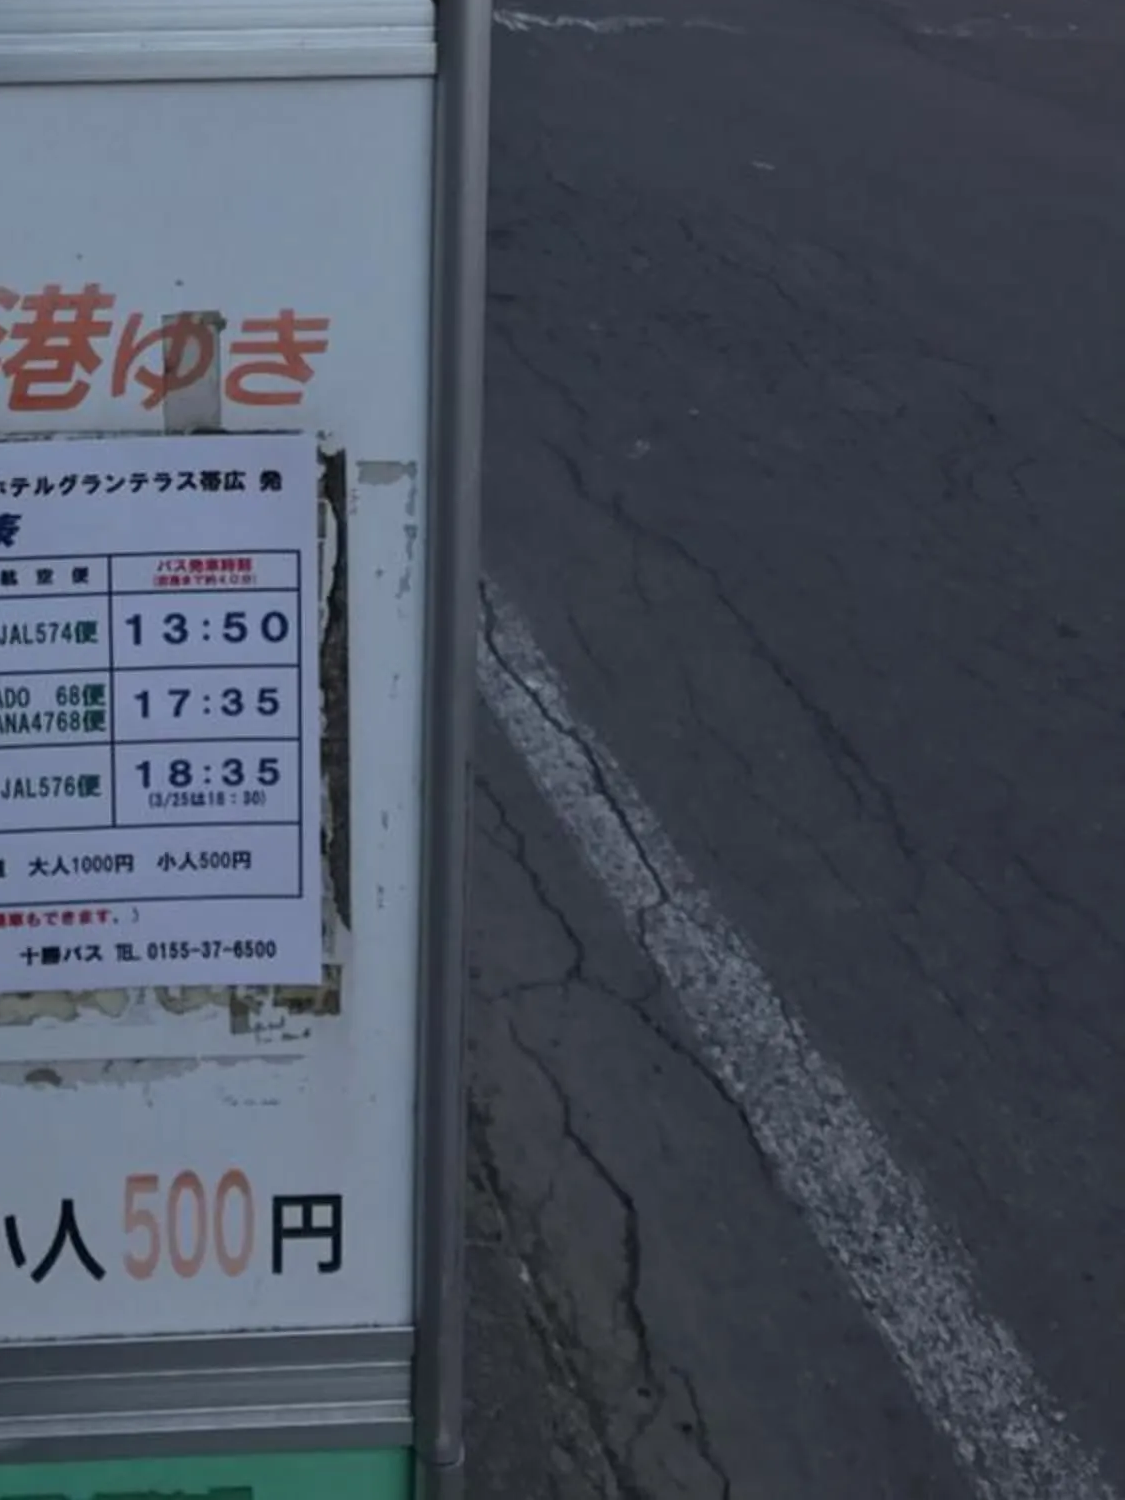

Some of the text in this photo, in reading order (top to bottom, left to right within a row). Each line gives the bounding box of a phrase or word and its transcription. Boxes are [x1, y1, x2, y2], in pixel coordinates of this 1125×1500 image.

[125, 611, 290, 647] 13:50
[55, 683, 106, 706] 68便
[133, 687, 281, 719] 17:35
[0, 773, 102, 799] JAL576便
[135, 756, 281, 789] 18:35
[28, 853, 135, 877] 大人1000円
[156, 850, 253, 873] 小人500円
